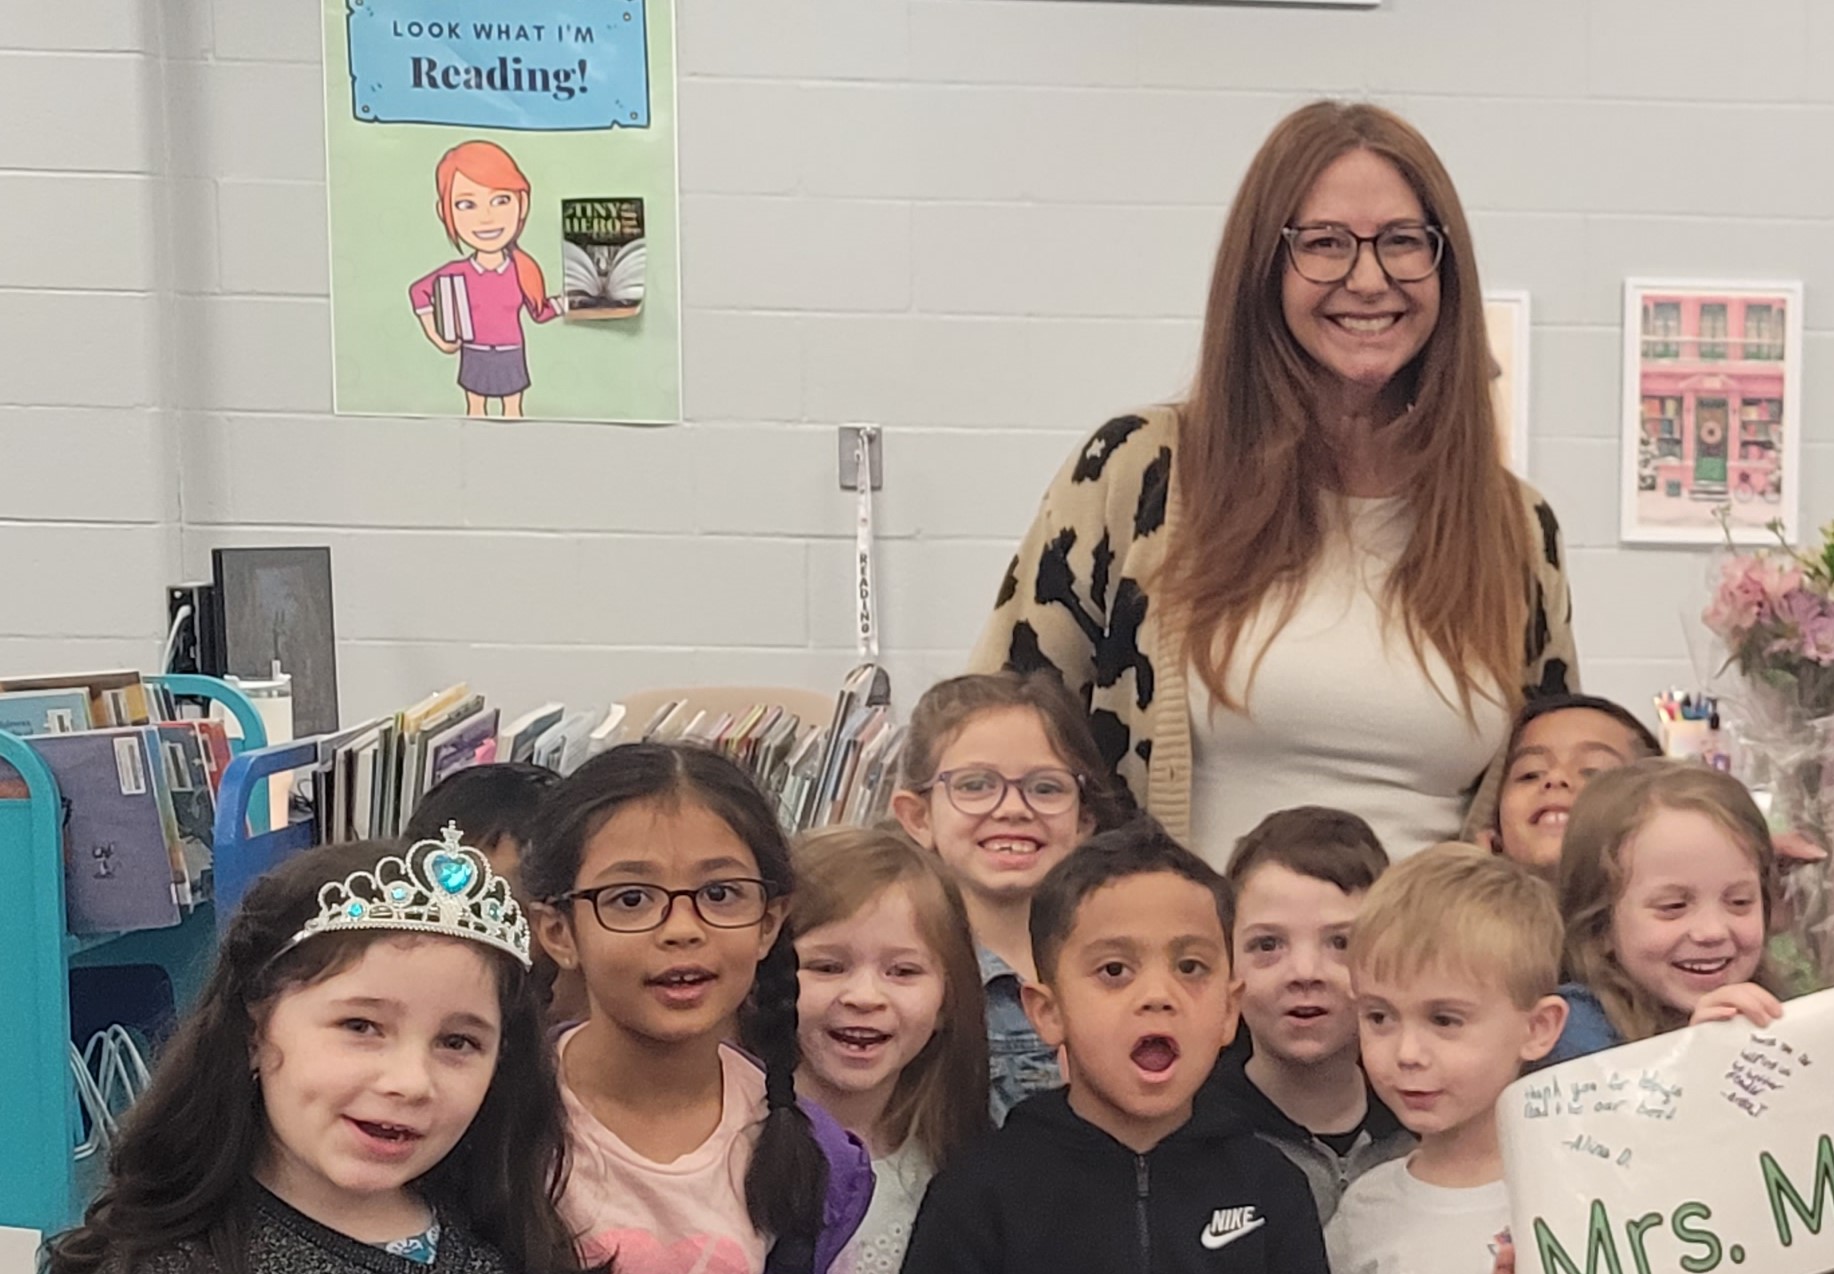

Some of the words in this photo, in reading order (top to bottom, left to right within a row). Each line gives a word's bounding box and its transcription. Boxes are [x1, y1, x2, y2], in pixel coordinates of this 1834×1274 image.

[393, 20, 461, 39] LOOK
[473, 23, 545, 42] WHAT
[558, 25, 595, 43] I'M
[411, 56, 588, 101] Reading!
[574, 202, 620, 217] TINY
[565, 218, 621, 233] HERO
[1210, 1206, 1256, 1233] NIKE
